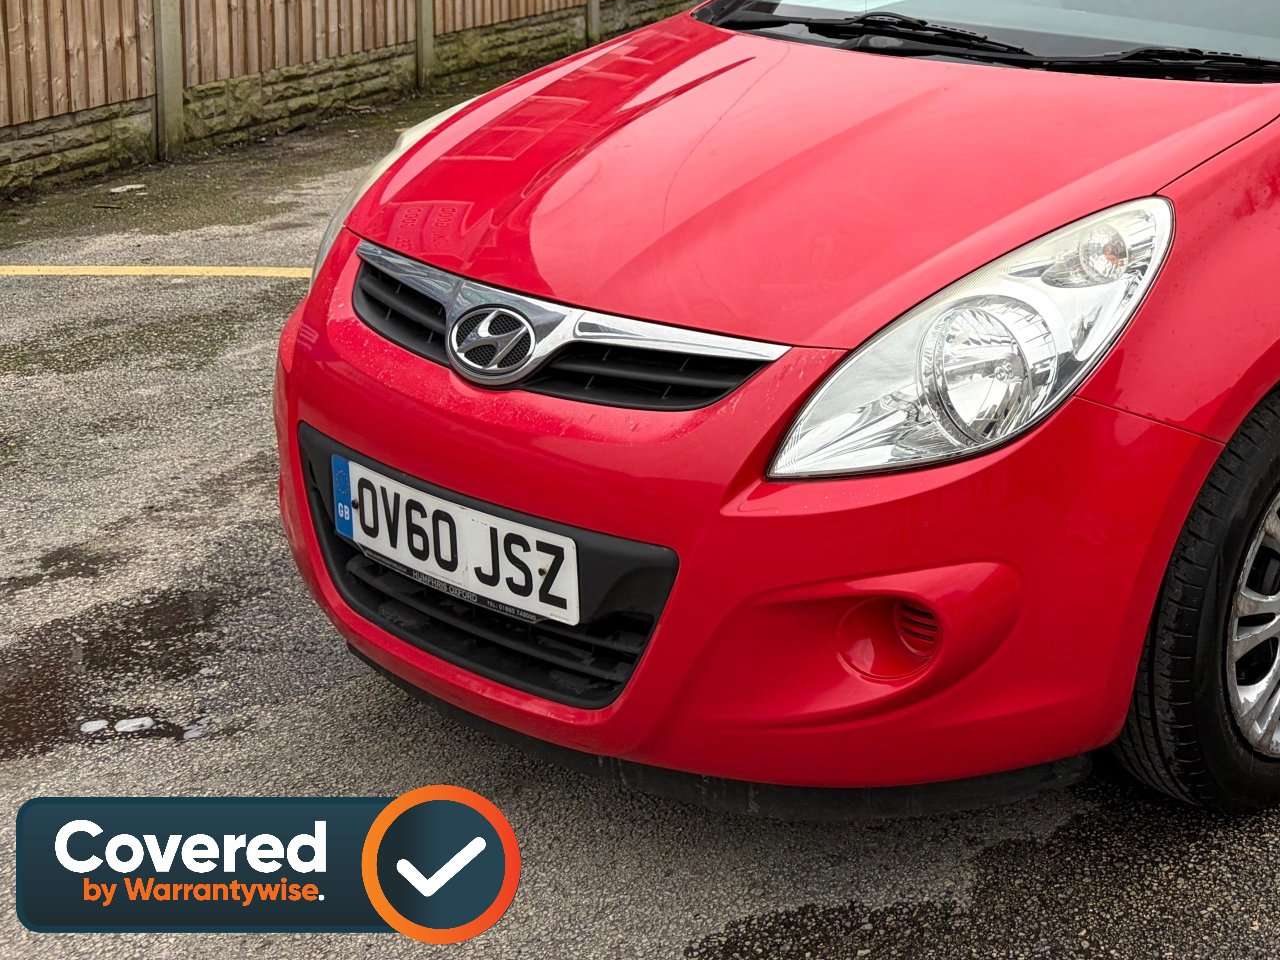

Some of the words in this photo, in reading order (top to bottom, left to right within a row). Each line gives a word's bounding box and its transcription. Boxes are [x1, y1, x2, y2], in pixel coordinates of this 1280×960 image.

[337, 502, 350, 521] GB
[356, 477, 459, 572] OV60
[474, 526, 568, 610] JSZ
[448, 585, 478, 603] OXFORD
